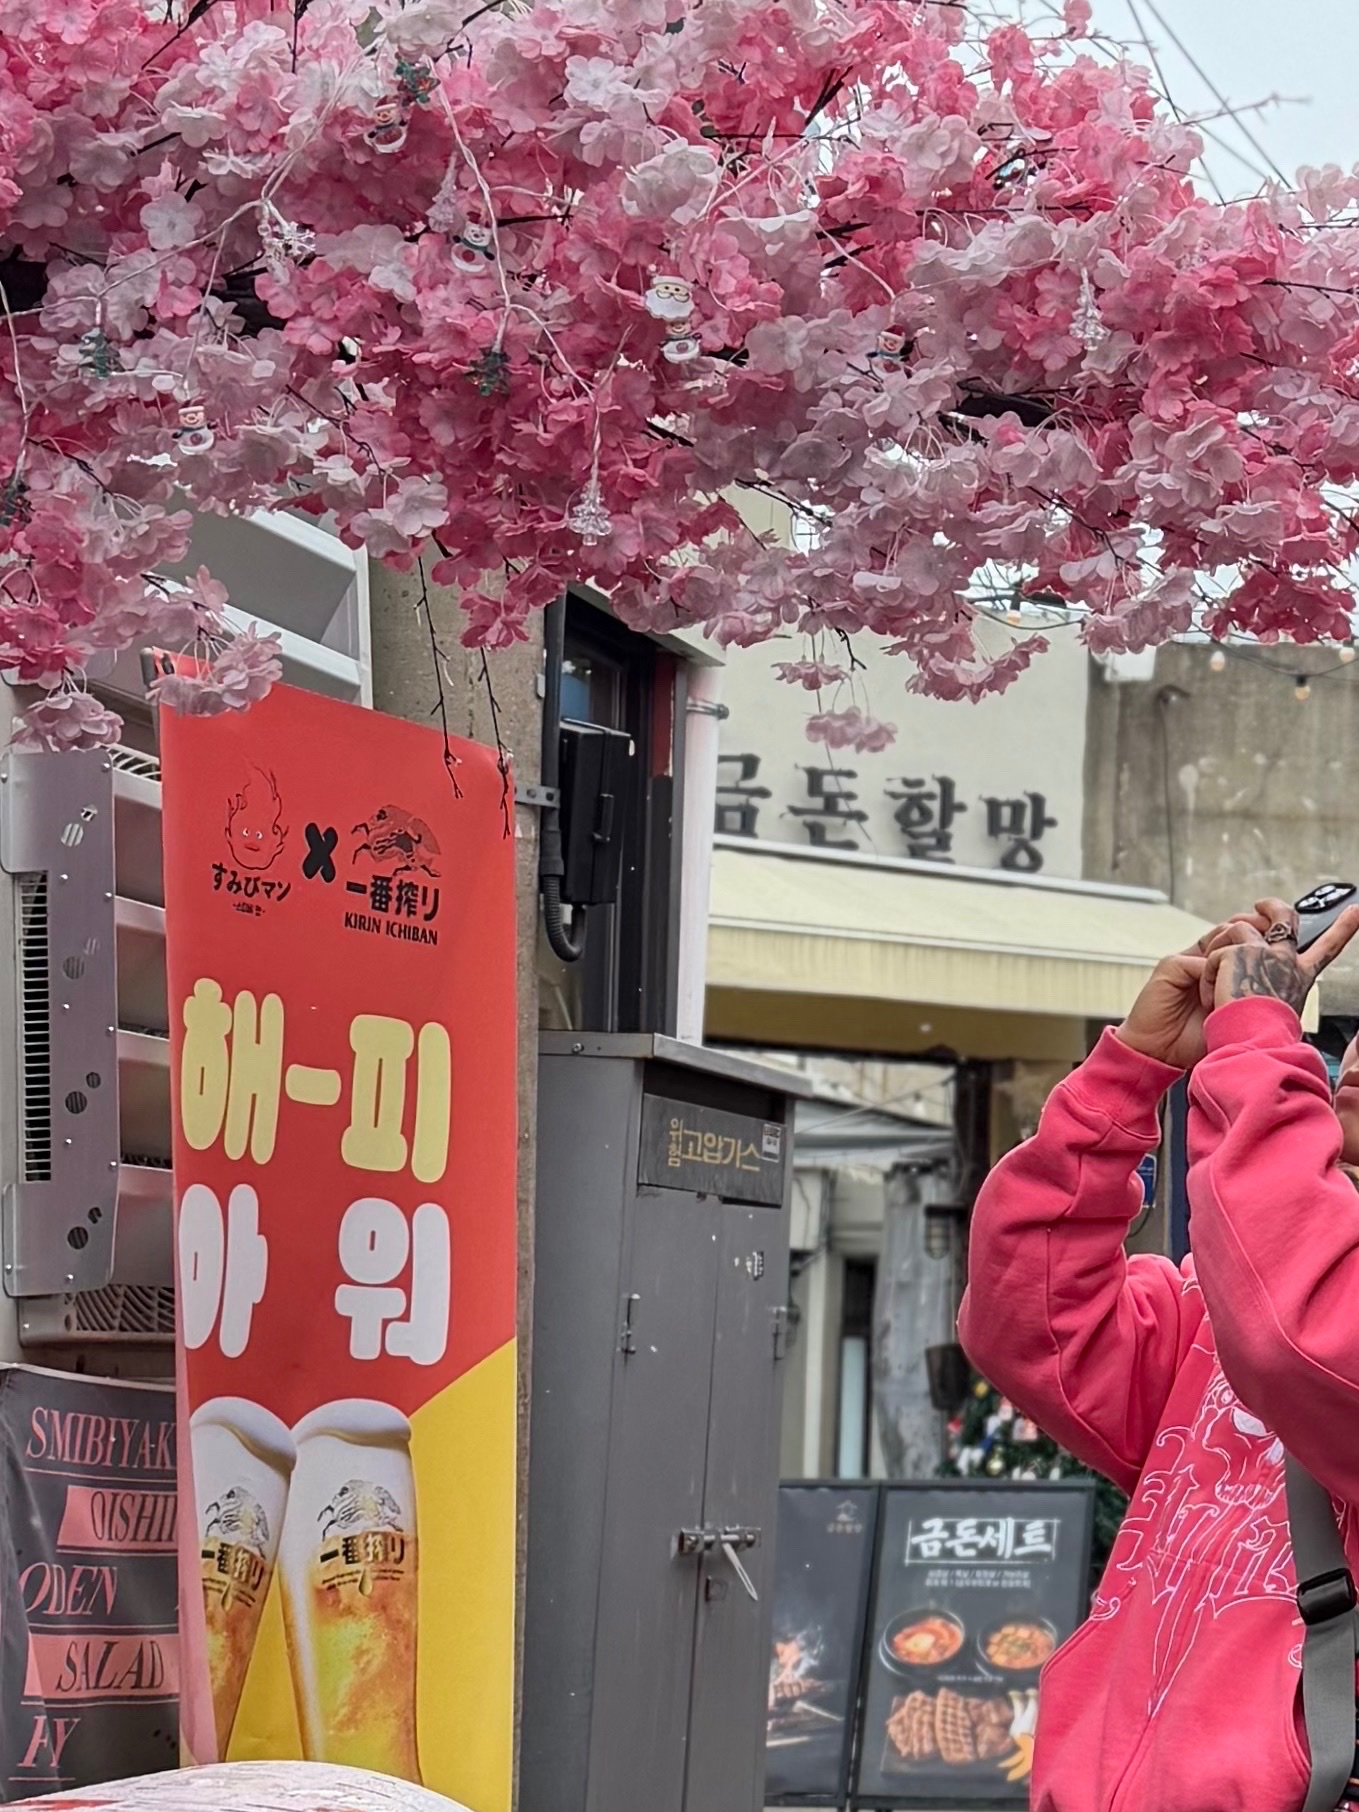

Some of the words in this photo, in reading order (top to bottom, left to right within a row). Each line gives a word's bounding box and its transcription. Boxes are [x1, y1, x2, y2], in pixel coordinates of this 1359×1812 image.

[713, 753, 1058, 875] 금돈할망
[211, 862, 292, 902] すみびマン
[345, 875, 440, 922] 一番搾り
[344, 911, 381, 934] KIRIN
[385, 919, 438, 946] ICHIBAN
[911, 1516, 1053, 1560] 금돈세트
[18, 1561, 118, 1616] ODEN
[55, 1640, 165, 1693] SALAD
